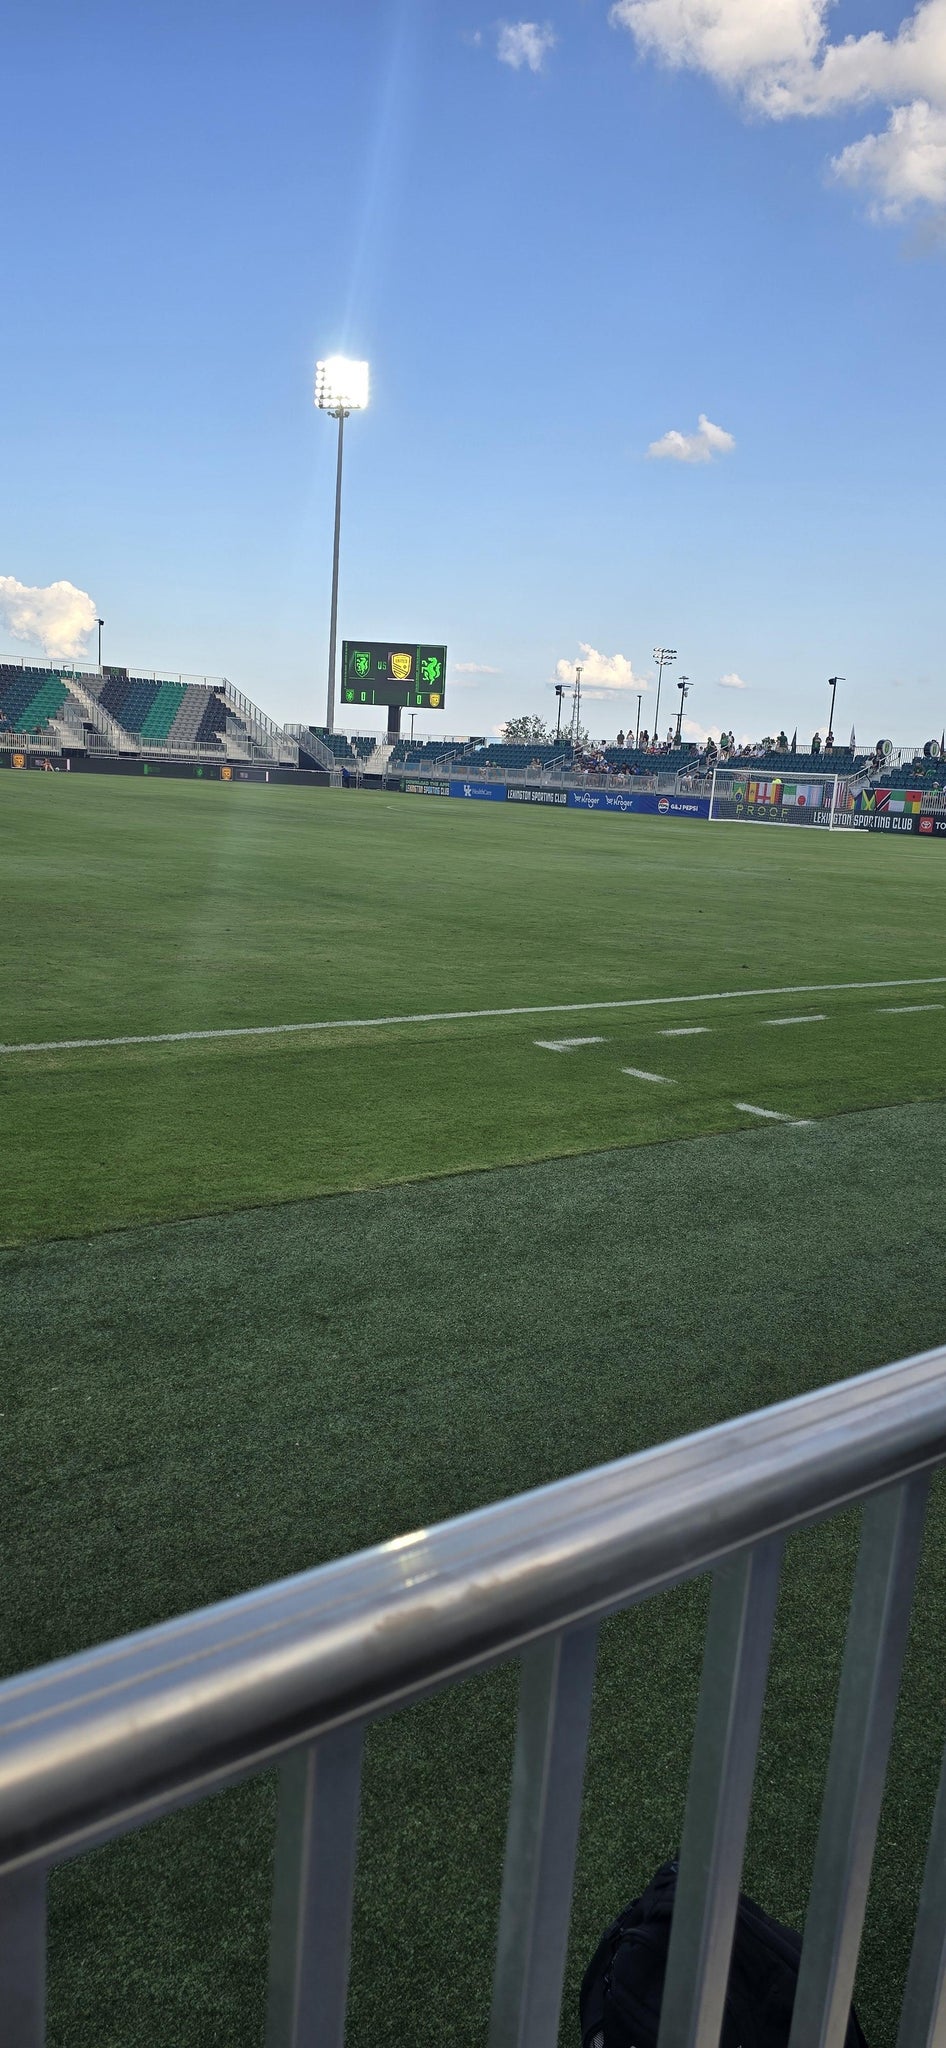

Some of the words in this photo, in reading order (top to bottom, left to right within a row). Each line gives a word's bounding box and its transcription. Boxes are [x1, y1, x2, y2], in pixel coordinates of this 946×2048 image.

[361, 691, 366, 701] 0
[417, 695, 422, 704] 0
[405, 784, 424, 793] LEXINGTON
[423, 785, 441, 795] SPORTING
[440, 787, 450, 796] CLUB
[507, 789, 532, 800] LEXINGTON
[531, 791, 554, 803] SPORTING
[554, 793, 567, 804] CLUB
[581, 792, 600, 808] Kroger
[613, 794, 633, 811] Kroger
[735, 804, 791, 818] PROOF
[892, 817, 913, 831] CLUB
